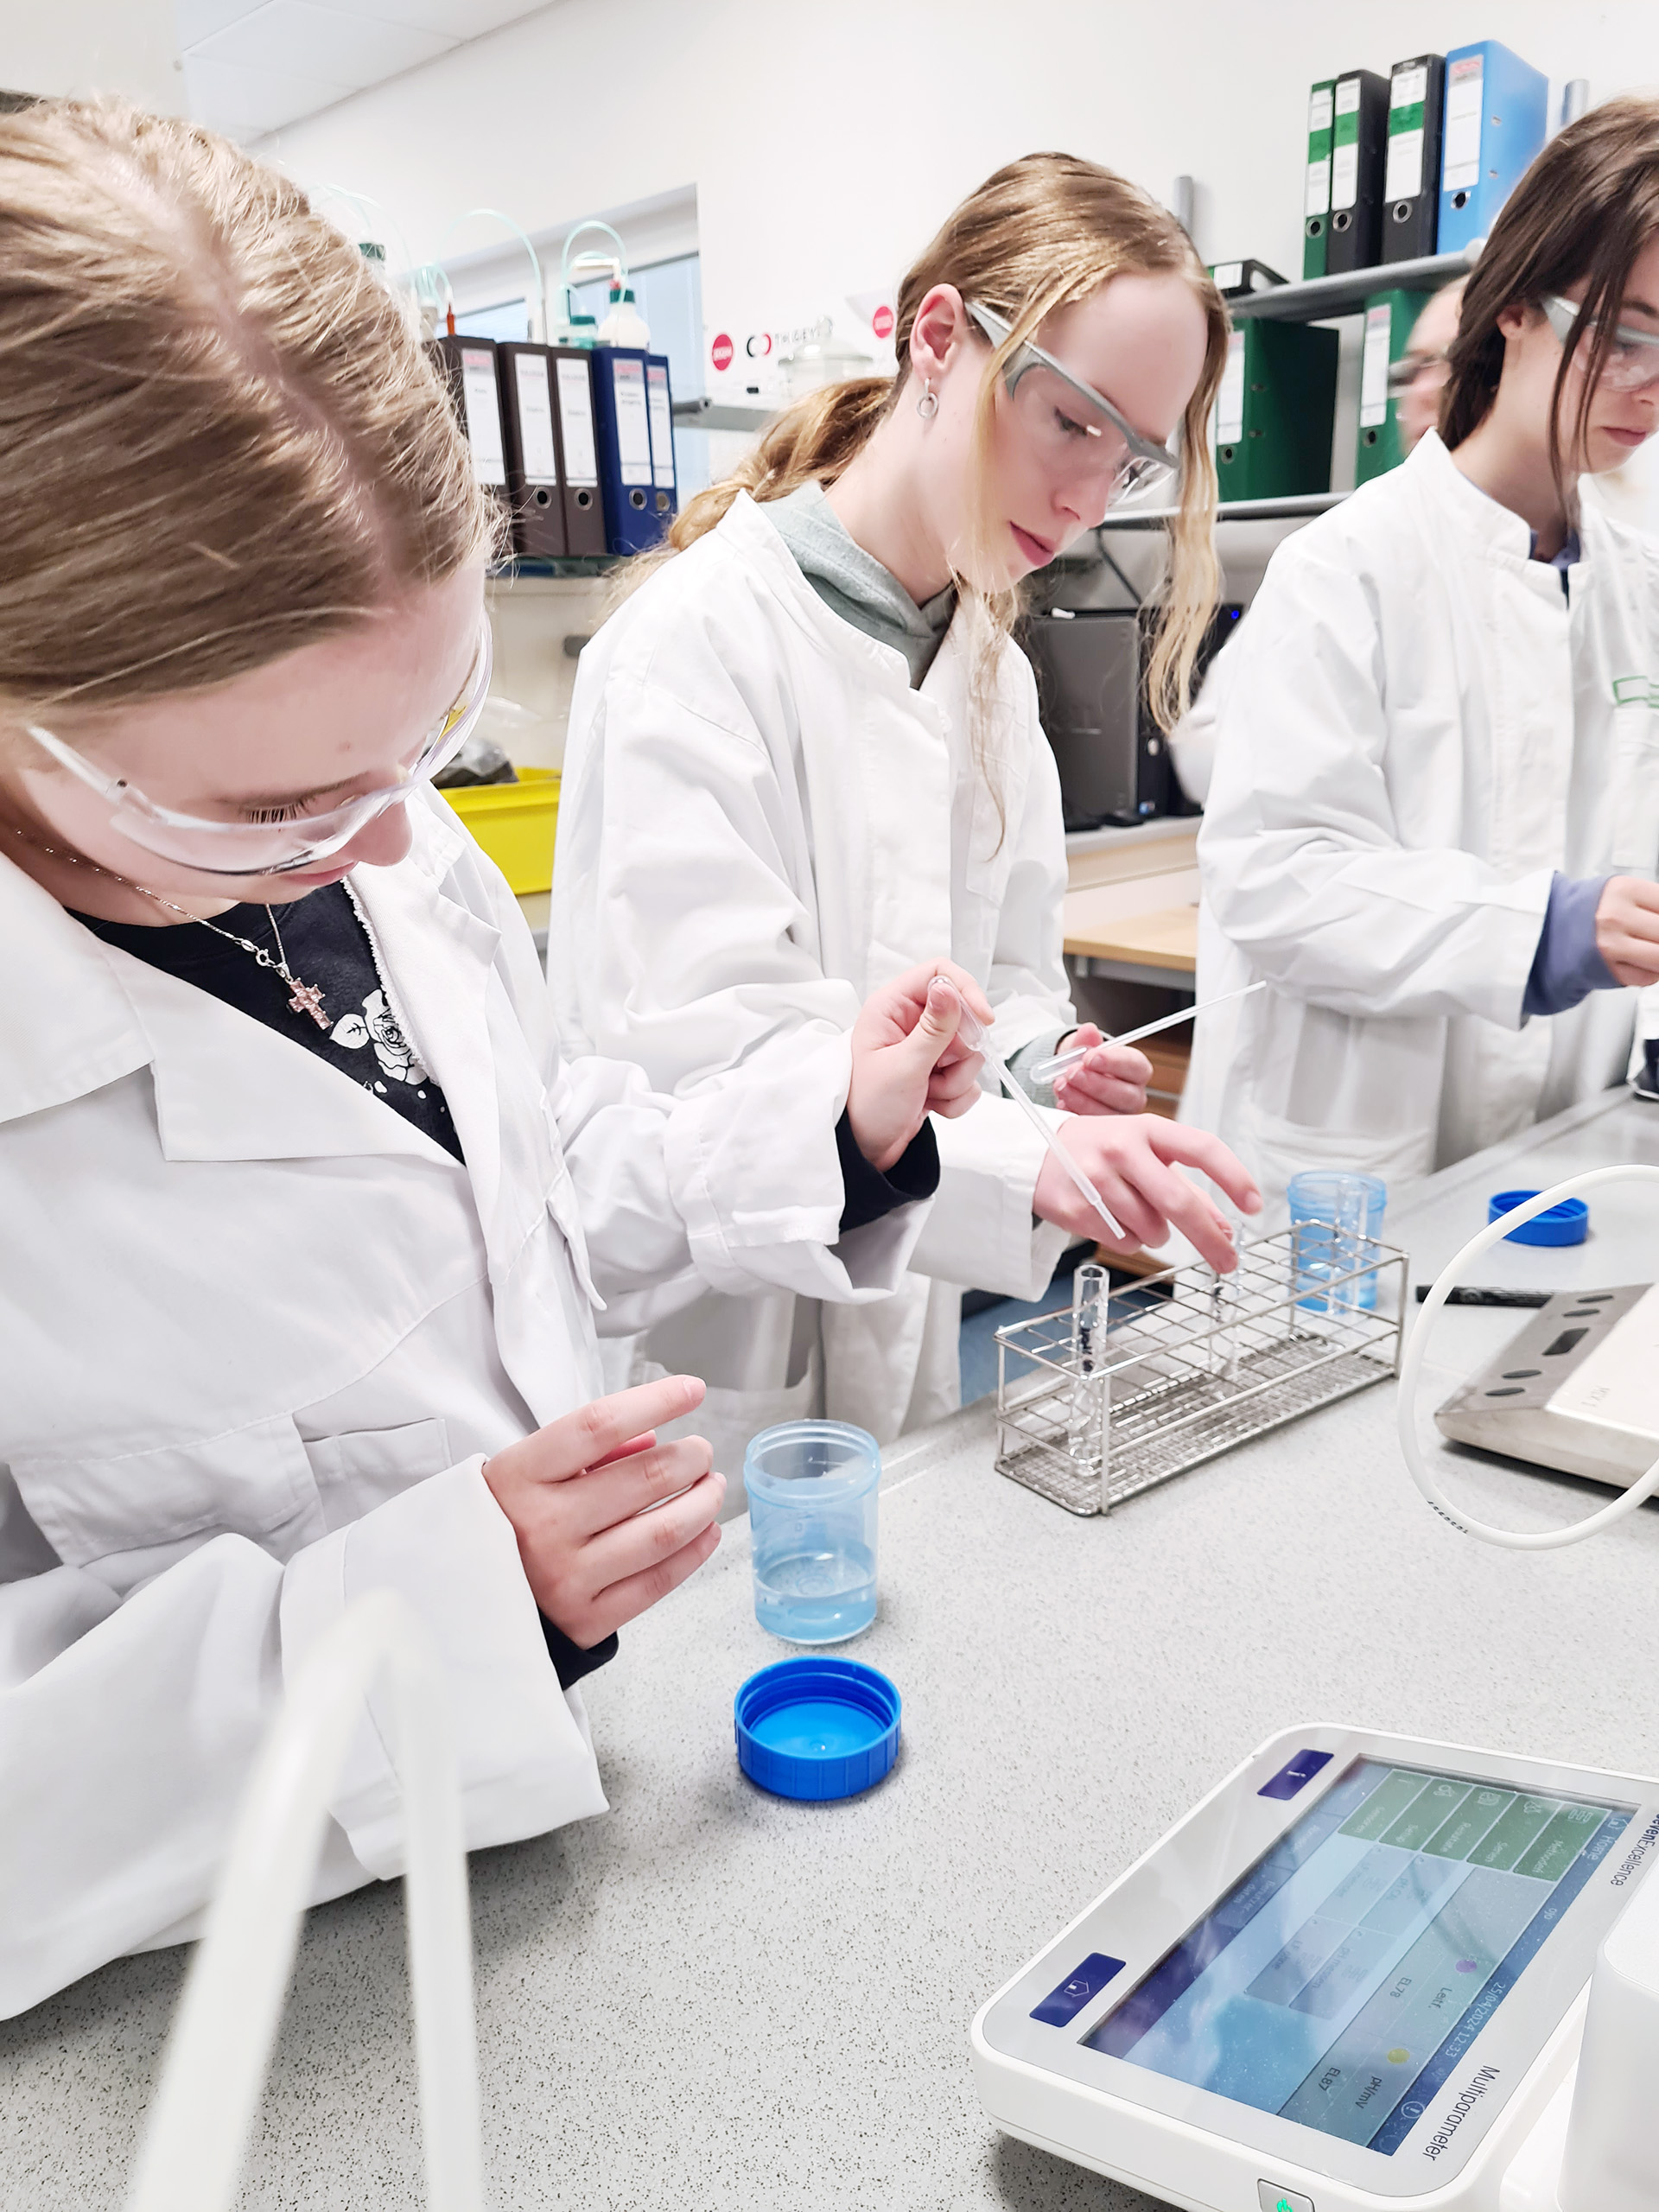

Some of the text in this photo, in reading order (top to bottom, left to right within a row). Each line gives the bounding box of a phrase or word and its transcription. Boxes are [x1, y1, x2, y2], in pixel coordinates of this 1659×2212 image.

[1586, 1834, 1616, 1861] Home
[1610, 1813, 1659, 1886] evenExcellence
[1388, 1977, 1412, 1998] EL78
[1442, 1981, 1507, 2057] 25/04/2024 12:33
[1314, 2067, 1341, 2091] EL87
[1351, 2076, 1385, 2108] pH/mV
[1421, 2065, 1501, 2161] Multiparameter
